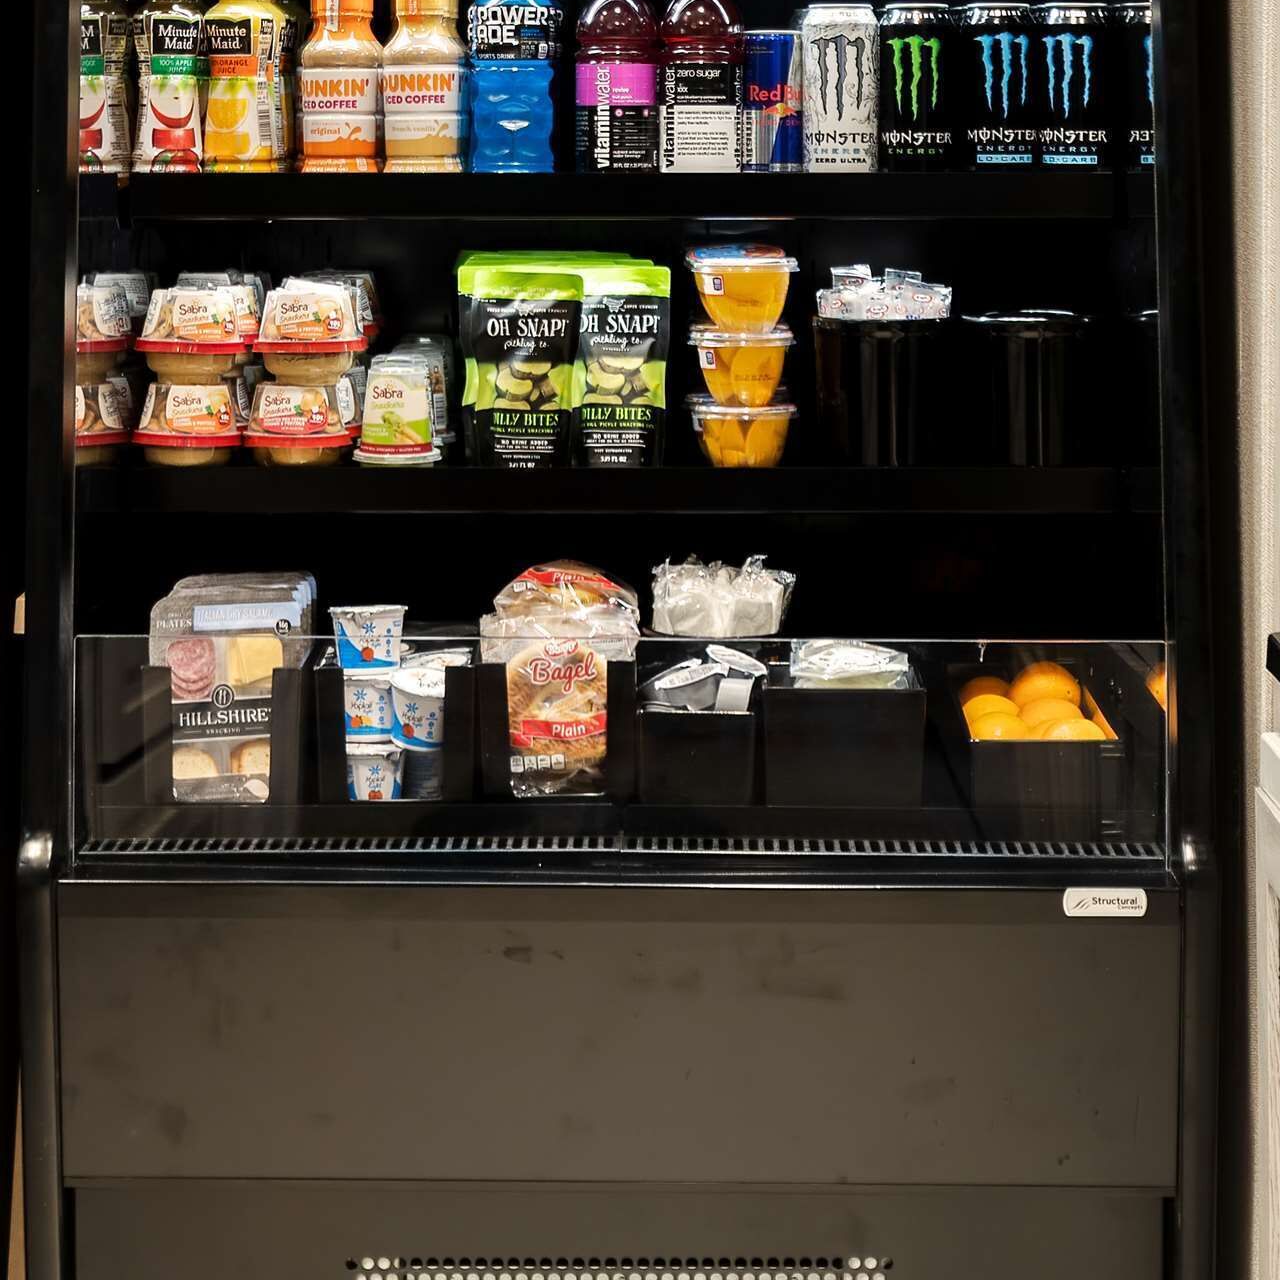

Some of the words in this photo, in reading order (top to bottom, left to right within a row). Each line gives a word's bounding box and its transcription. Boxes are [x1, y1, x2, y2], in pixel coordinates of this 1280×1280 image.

[478, 6, 548, 25] POWER
[158, 24, 198, 37] Minute
[207, 24, 246, 37] Minute
[477, 26, 519, 44] ADE
[164, 37, 193, 50] Maid
[211, 37, 241, 49] Maid
[676, 69, 695, 78] zero
[696, 69, 721, 80] sugar
[405, 95, 446, 104] COFFEE
[749, 84, 780, 101] Red
[317, 99, 358, 109] COFFEE
[663, 67, 676, 168] vitaminwater
[806, 130, 876, 146] MONSTER
[881, 130, 953, 146] MONSTER
[1040, 127, 1108, 144] MONSTER
[179, 303, 208, 316] Sabra
[280, 303, 309, 315] Sabra
[486, 318, 511, 337] OH
[516, 318, 566, 337] SNAP!
[580, 315, 599, 333] OH
[606, 314, 658, 333] SNAP!
[590, 336, 629, 350] pickling
[372, 385, 403, 399] Sabra
[173, 395, 202, 408] Sabra
[264, 395, 291, 407] Sabra
[524, 412, 559, 426] BITES
[616, 408, 651, 420] BITES
[156, 618, 192, 629] PLATES
[529, 651, 597, 694] Bagel
[179, 708, 269, 727] HILLSHIRE
[552, 723, 586, 738] Plain
[1092, 896, 1138, 905] Structural
